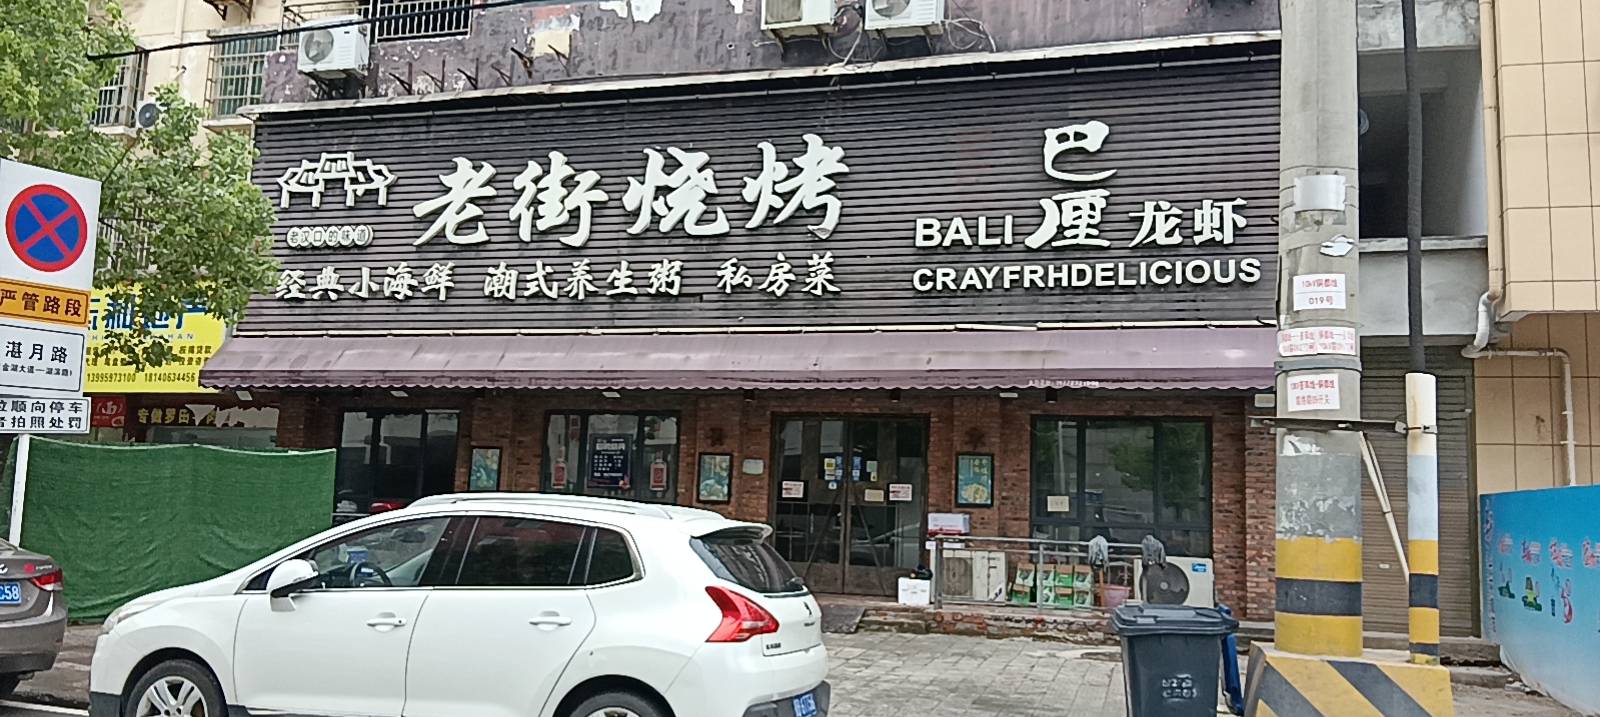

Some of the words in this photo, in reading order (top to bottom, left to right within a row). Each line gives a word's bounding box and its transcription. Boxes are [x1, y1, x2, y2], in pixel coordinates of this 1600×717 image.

[412, 133, 850, 249] 老街烧烤
[288, 225, 370, 246] 老汉口的味道
[915, 214, 1014, 248] BALI
[1128, 197, 1248, 248] 龙虾
[275, 262, 456, 301] 经典小海鲜
[483, 257, 684, 300] 潮式养生粥
[716, 252, 841, 297] 私房菜
[912, 258, 1262, 292] CRAYFRHDELICIOUS
[0, 288, 83, 318] 严管路段
[5, 340, 68, 364] 湛月路
